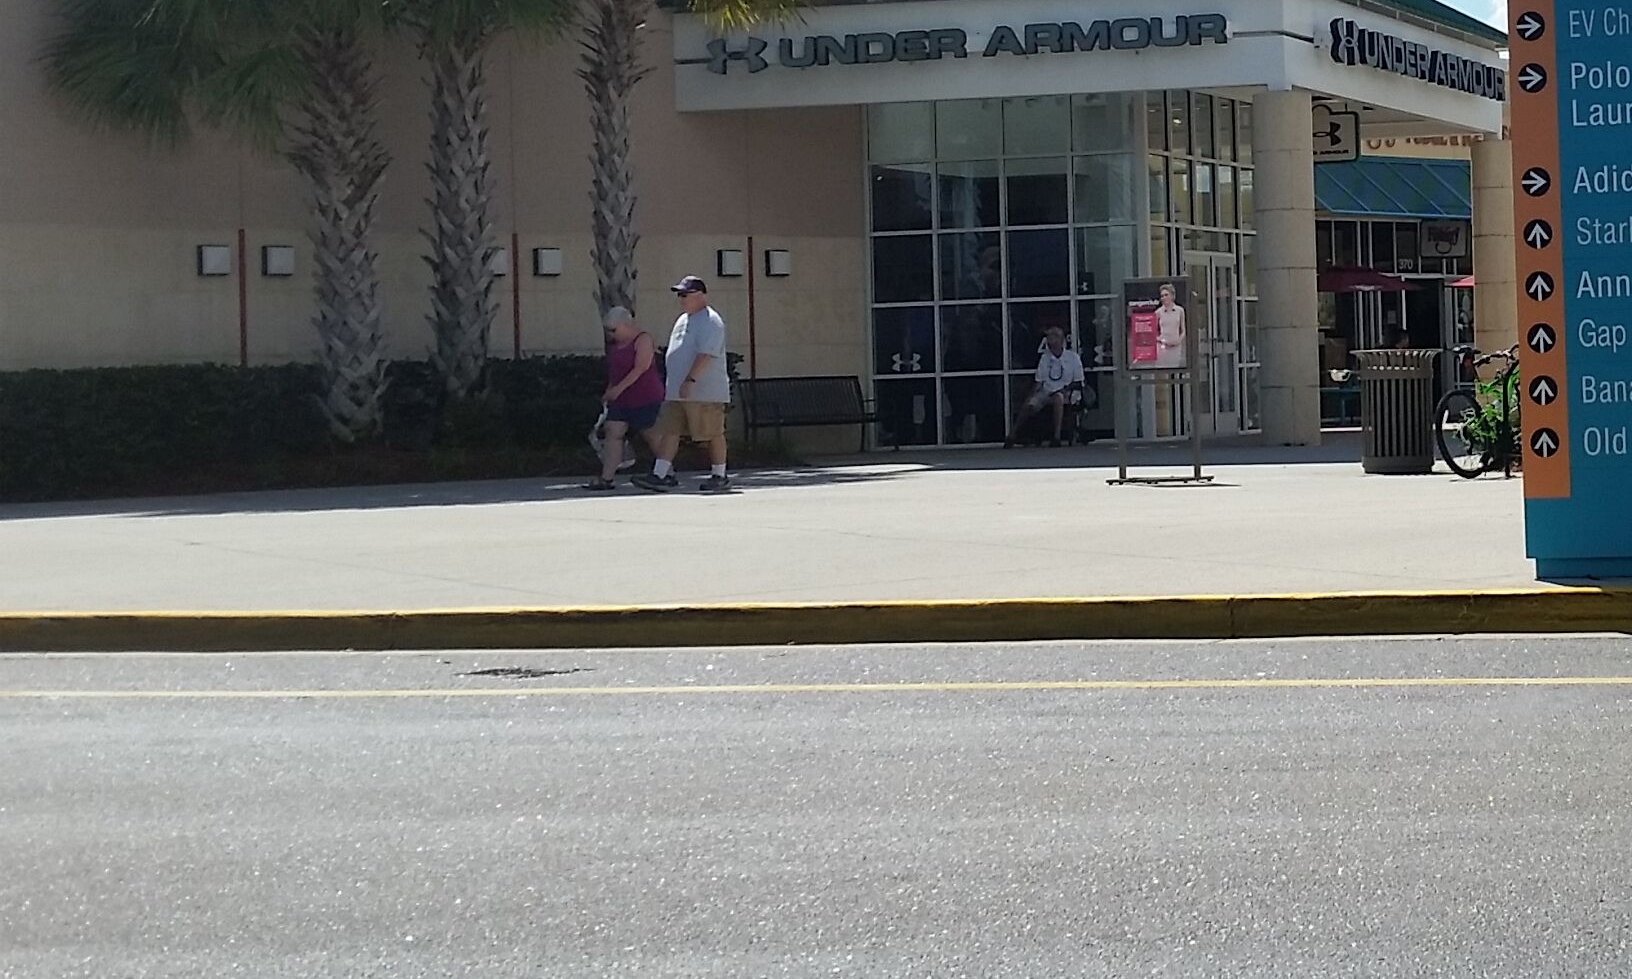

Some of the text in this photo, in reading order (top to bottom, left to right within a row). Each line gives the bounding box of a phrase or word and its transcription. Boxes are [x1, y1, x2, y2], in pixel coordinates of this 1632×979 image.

[1568, 9, 1596, 38] EV
[778, 13, 1229, 69] UNDER ARMOUR
[1358, 28, 1506, 102] UNDER ARMOUR
[1570, 60, 1631, 91] Polo
[1398, 258, 1414, 270] 370
[1576, 270, 1631, 298] Ann
[1578, 319, 1627, 353] Gap
[1583, 426, 1627, 456] Old
